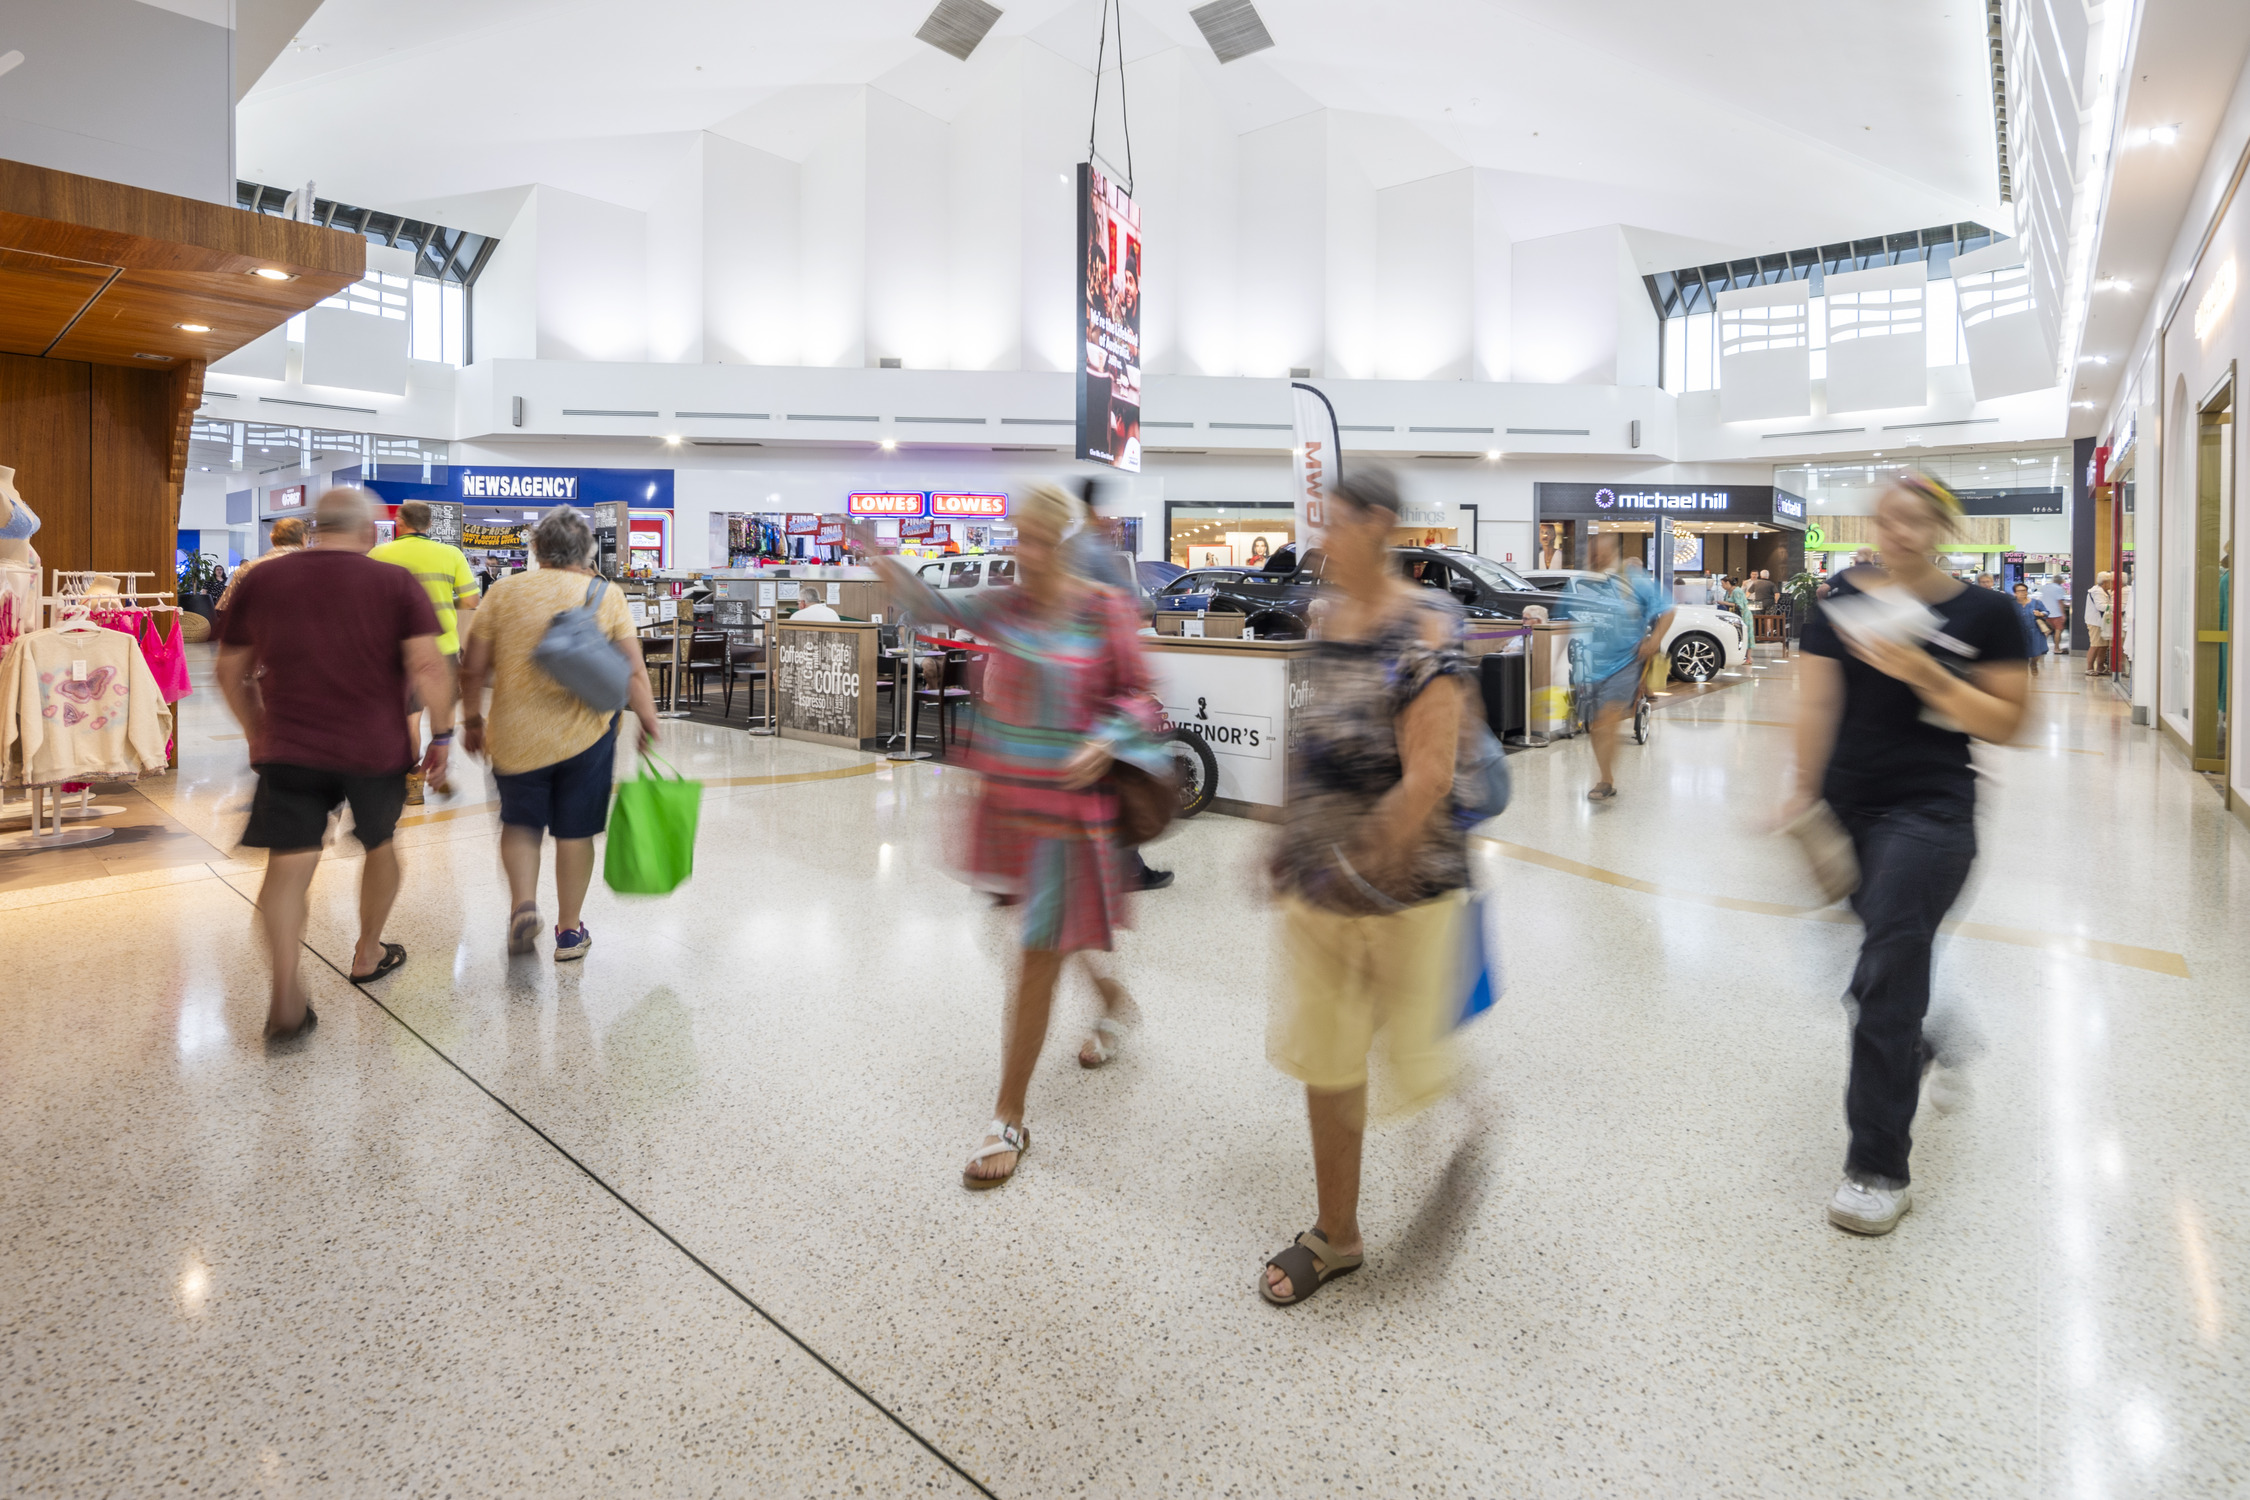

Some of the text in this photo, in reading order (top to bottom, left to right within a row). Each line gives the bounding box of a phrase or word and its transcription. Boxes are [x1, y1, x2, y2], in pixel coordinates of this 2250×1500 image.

[463, 475, 576, 498] NEWSAGENCY
[852, 497, 918, 512] LOWES
[936, 498, 1003, 513] LOWES
[1618, 492, 1728, 509] michael hill
[791, 514, 819, 524] FINAL
[464, 524, 488, 535] GOLD
[820, 524, 842, 535] FINAL
[762, 610, 768, 619] 2
[780, 645, 804, 664] Coffee
[831, 643, 850, 663] Café
[815, 662, 860, 698] coffee
[799, 691, 826, 710] Espresso
